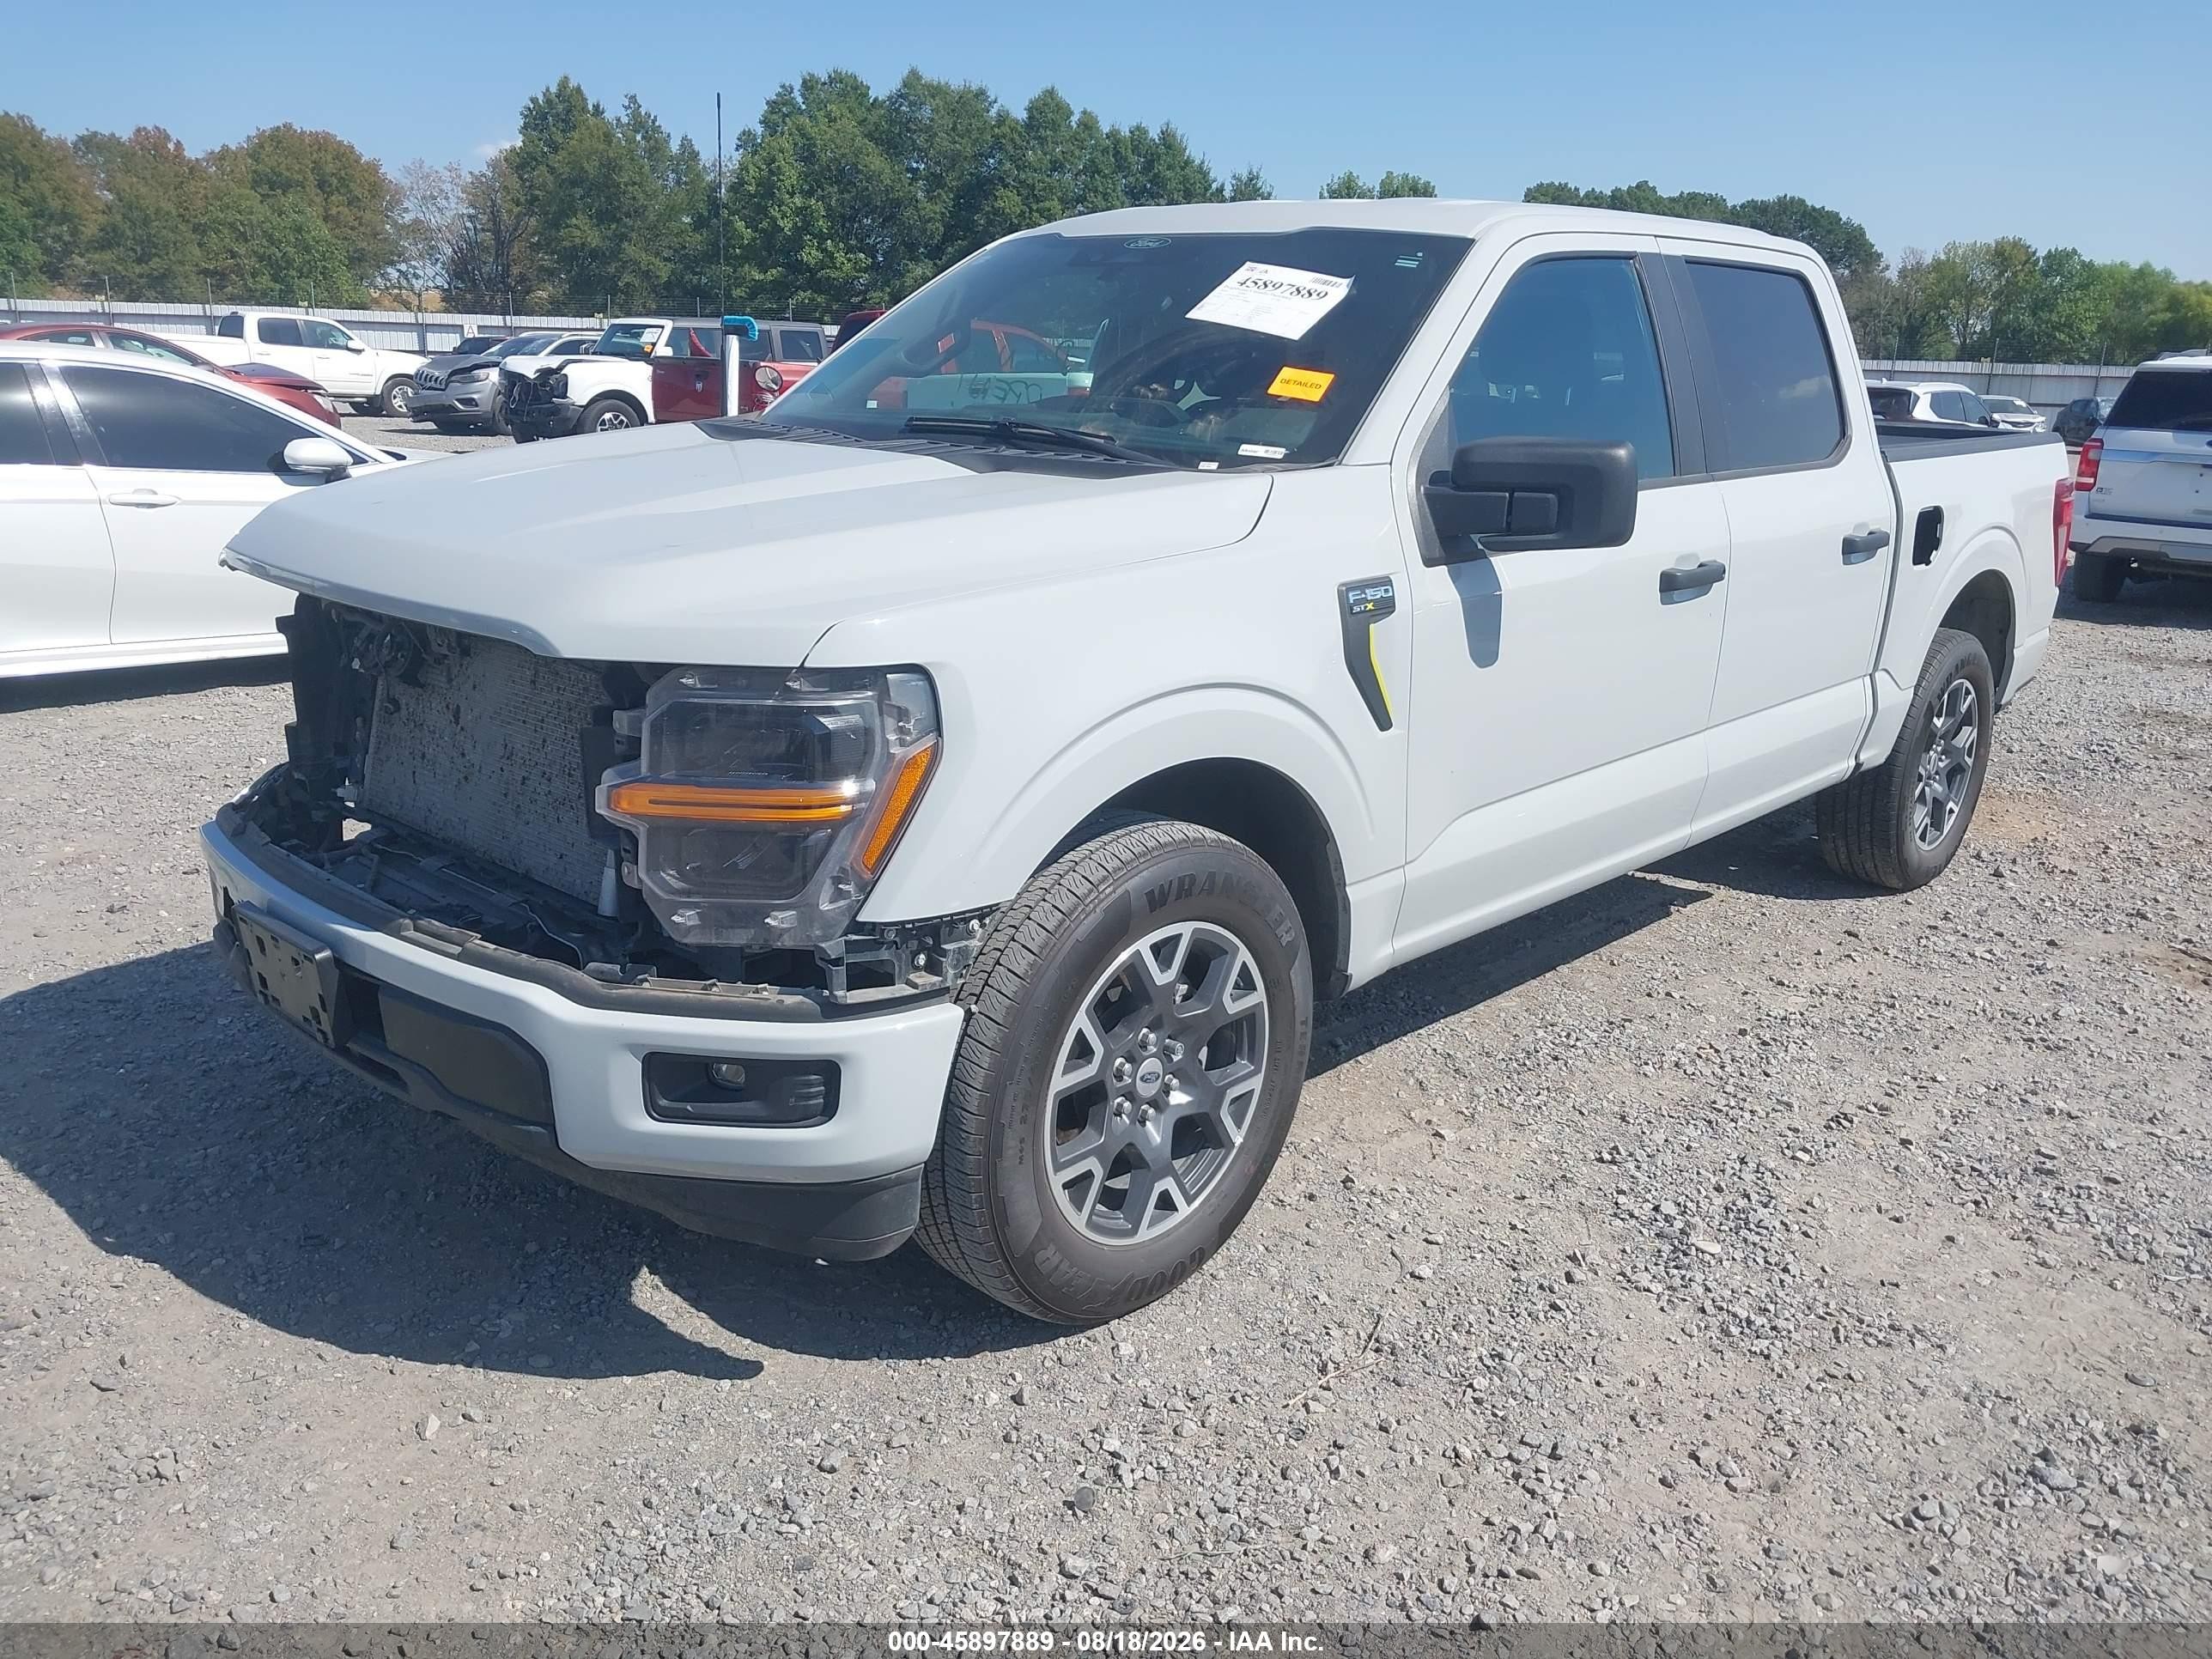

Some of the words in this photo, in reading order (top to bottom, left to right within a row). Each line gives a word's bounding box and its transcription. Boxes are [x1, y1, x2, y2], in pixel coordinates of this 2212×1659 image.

[1237, 276, 1328, 301] 45897889
[1279, 378, 1322, 390] DETAILED
[1348, 586, 1393, 604] F-150
[1352, 602, 1375, 613] STX
